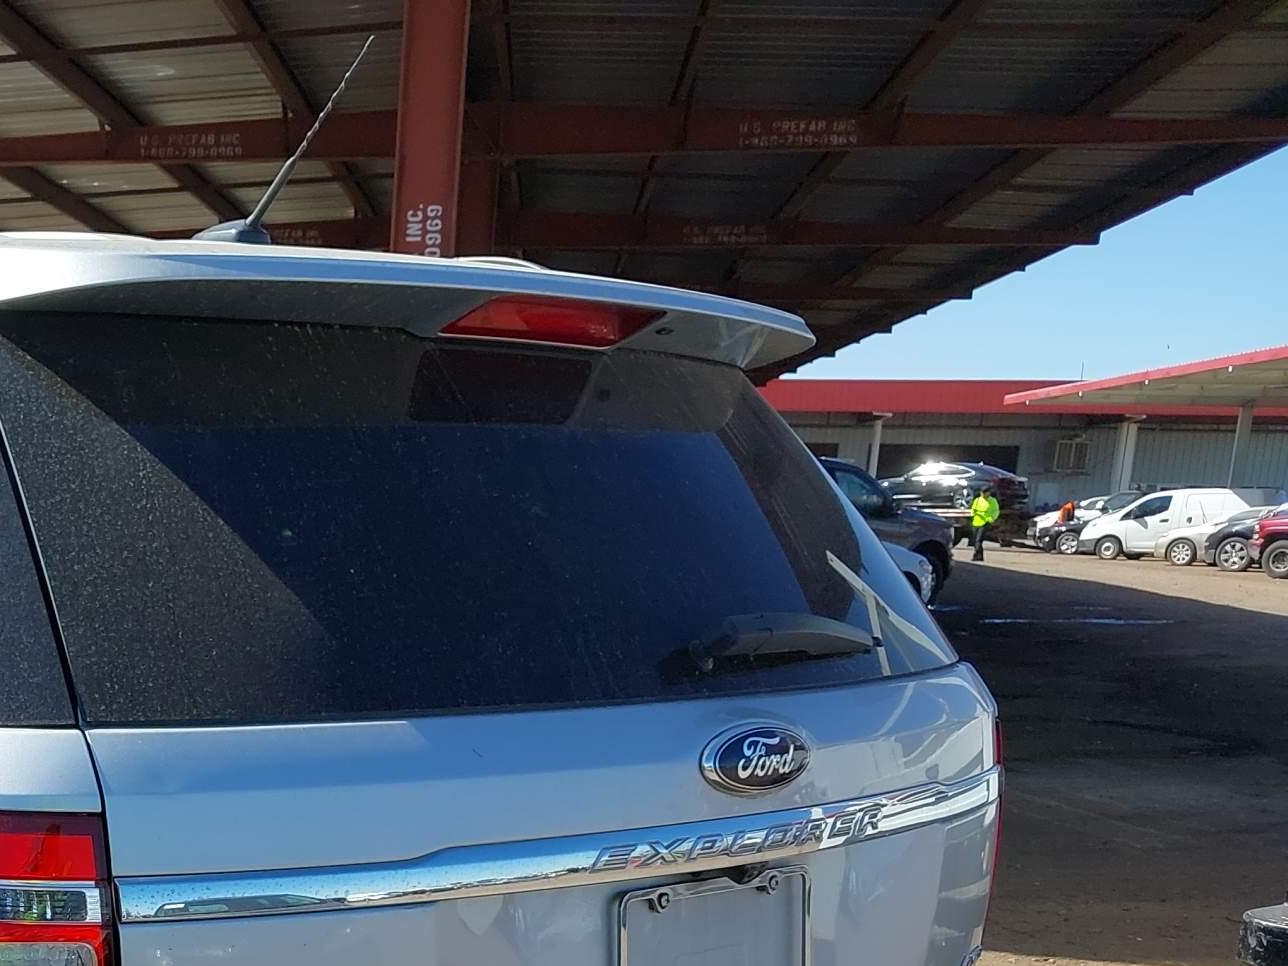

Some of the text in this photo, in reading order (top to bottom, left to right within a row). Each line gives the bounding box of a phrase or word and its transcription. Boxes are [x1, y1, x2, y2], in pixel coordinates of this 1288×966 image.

[406, 203, 424, 243] INC.
[738, 737, 795, 780] Ford
[589, 805, 884, 873] EXPLORER
